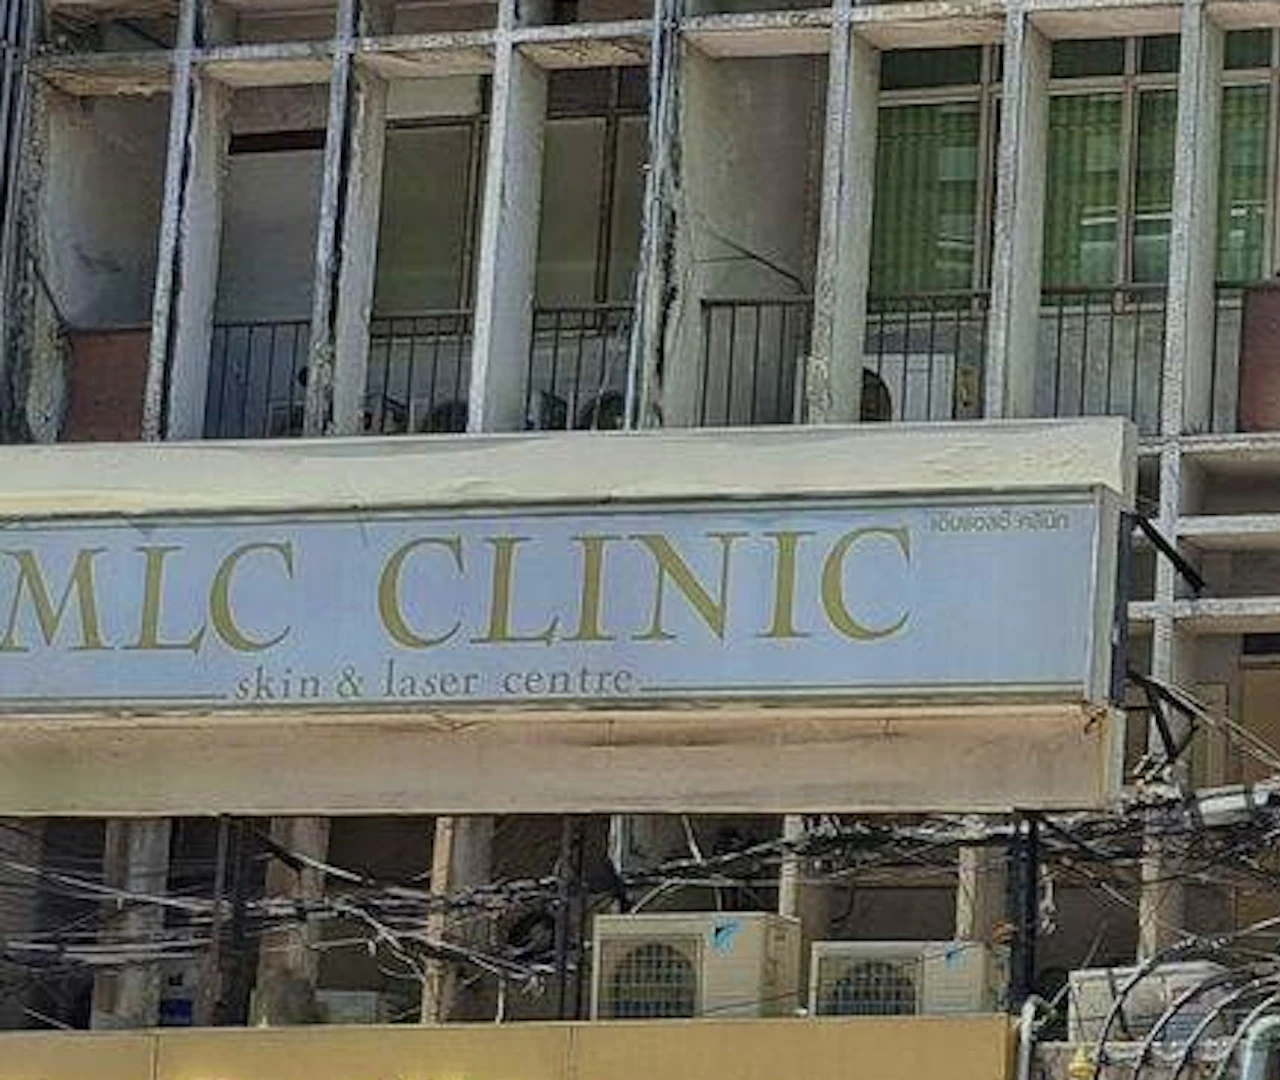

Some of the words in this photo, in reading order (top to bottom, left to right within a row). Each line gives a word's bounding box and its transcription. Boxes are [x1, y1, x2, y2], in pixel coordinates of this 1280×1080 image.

[0, 540, 294, 652] MLC
[377, 527, 912, 650] CLINIC
[235, 666, 320, 700] skin
[336, 667, 365, 698] &
[384, 658, 479, 698] laser
[503, 665, 635, 696] centre
